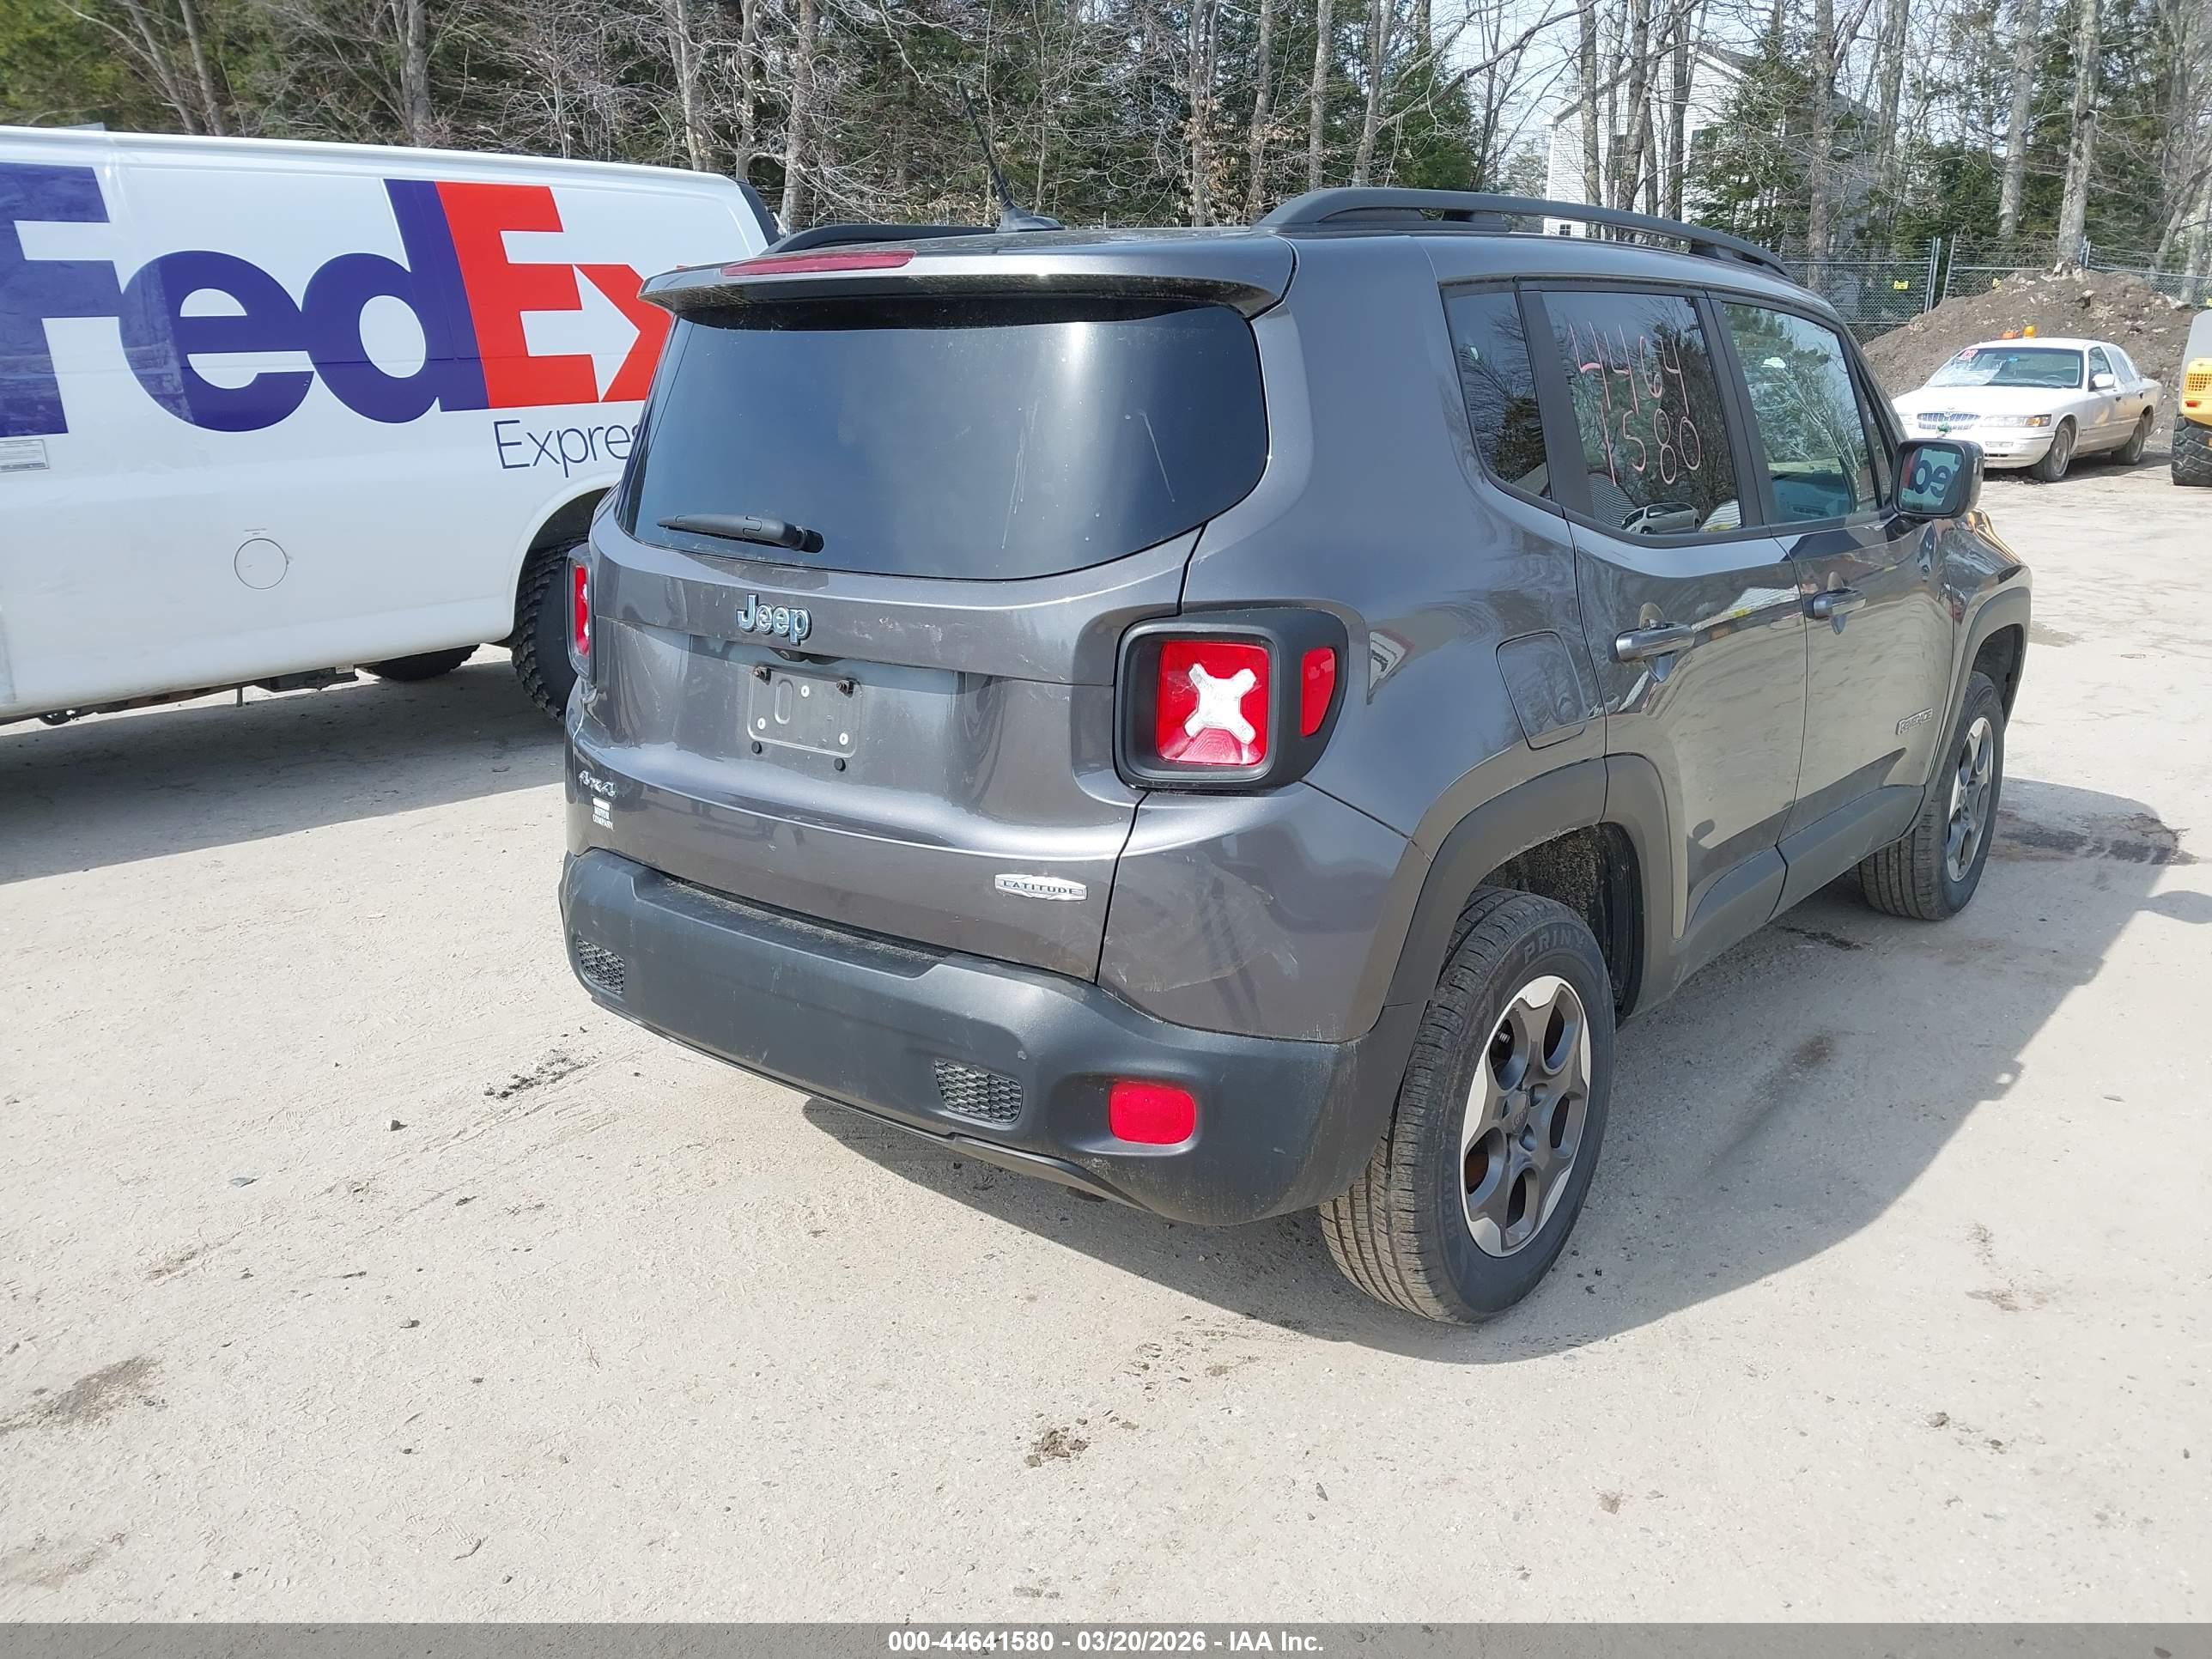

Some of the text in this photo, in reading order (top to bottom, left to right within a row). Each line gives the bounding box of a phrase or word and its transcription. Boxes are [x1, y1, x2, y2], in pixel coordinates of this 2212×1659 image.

[1569, 321, 1690, 416] 4464
[1600, 402, 1701, 487] 1580
[736, 593, 811, 646] Jeep
[1003, 880, 1078, 895] LATITUDE
